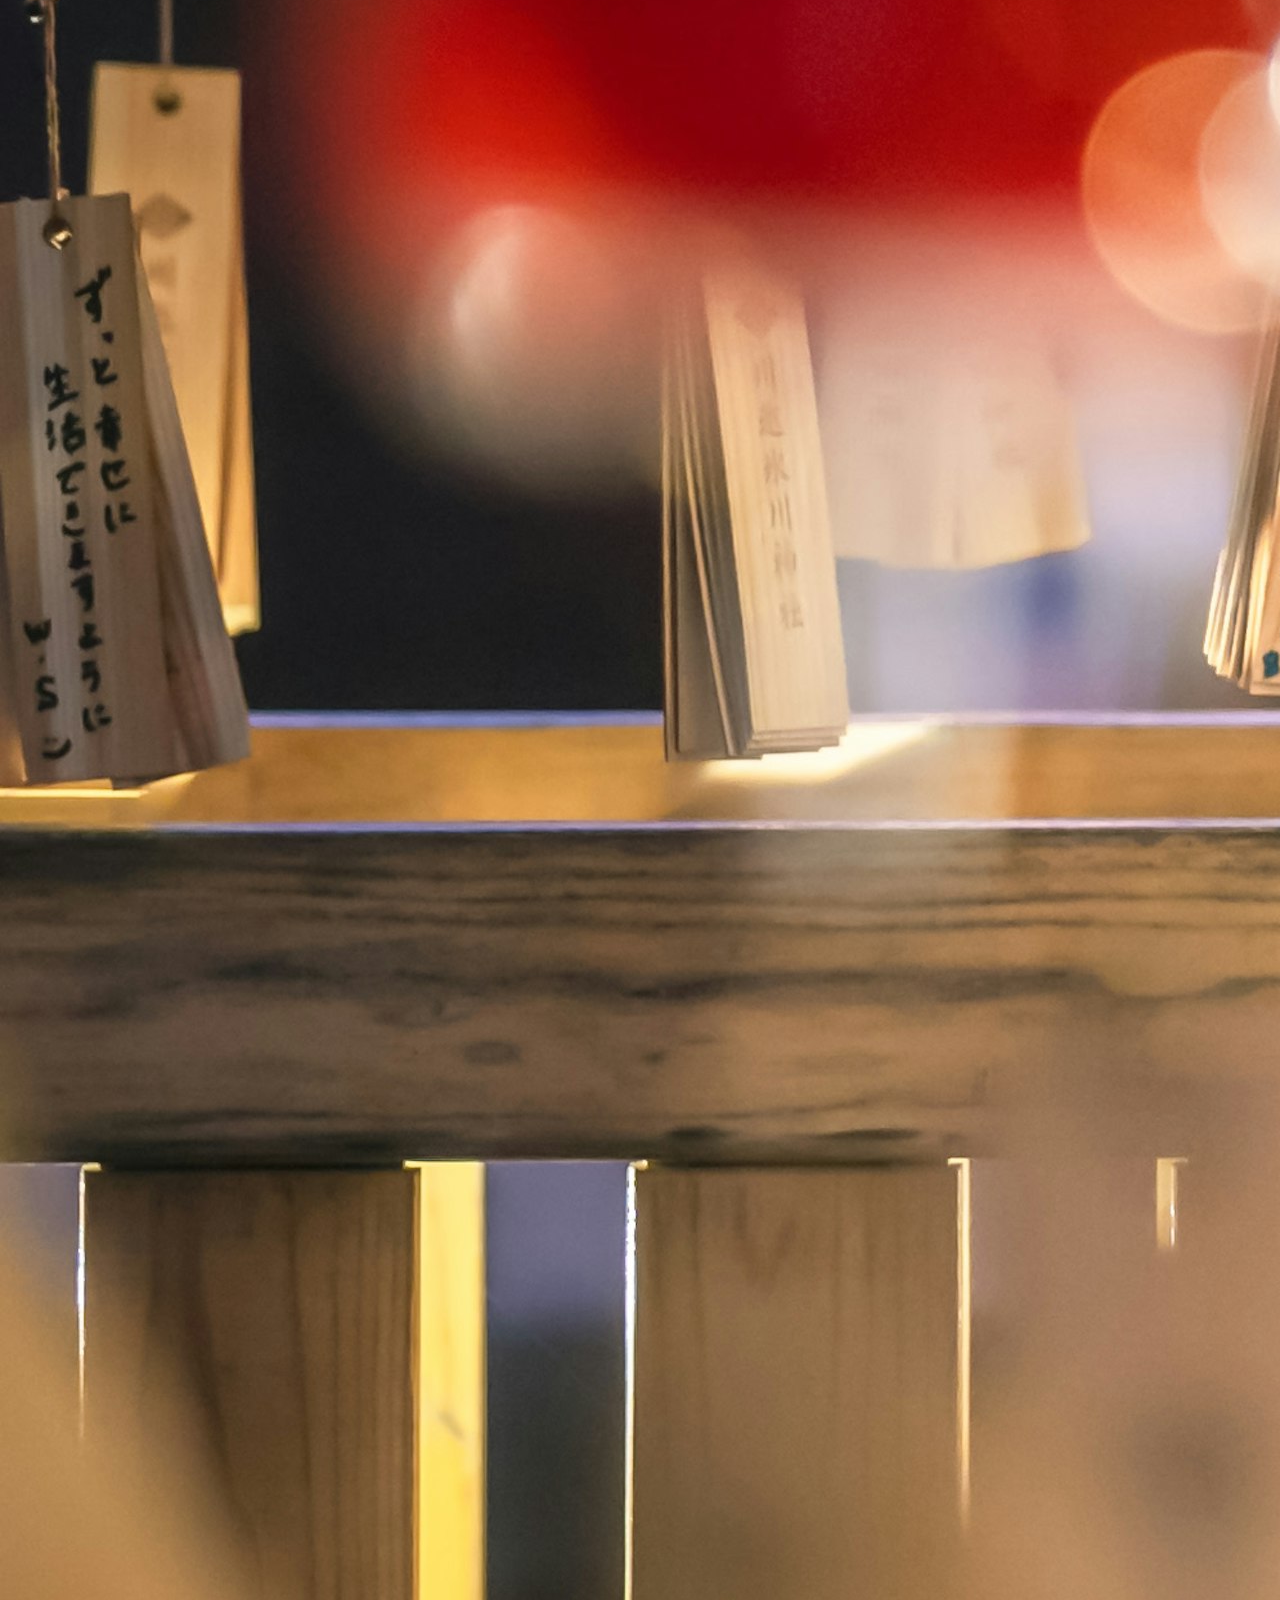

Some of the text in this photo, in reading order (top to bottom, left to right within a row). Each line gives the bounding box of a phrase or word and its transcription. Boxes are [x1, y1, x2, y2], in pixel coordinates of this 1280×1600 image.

[43, 362, 113, 735] 生活できますように
[75, 264, 138, 535] ずっと幸せに
